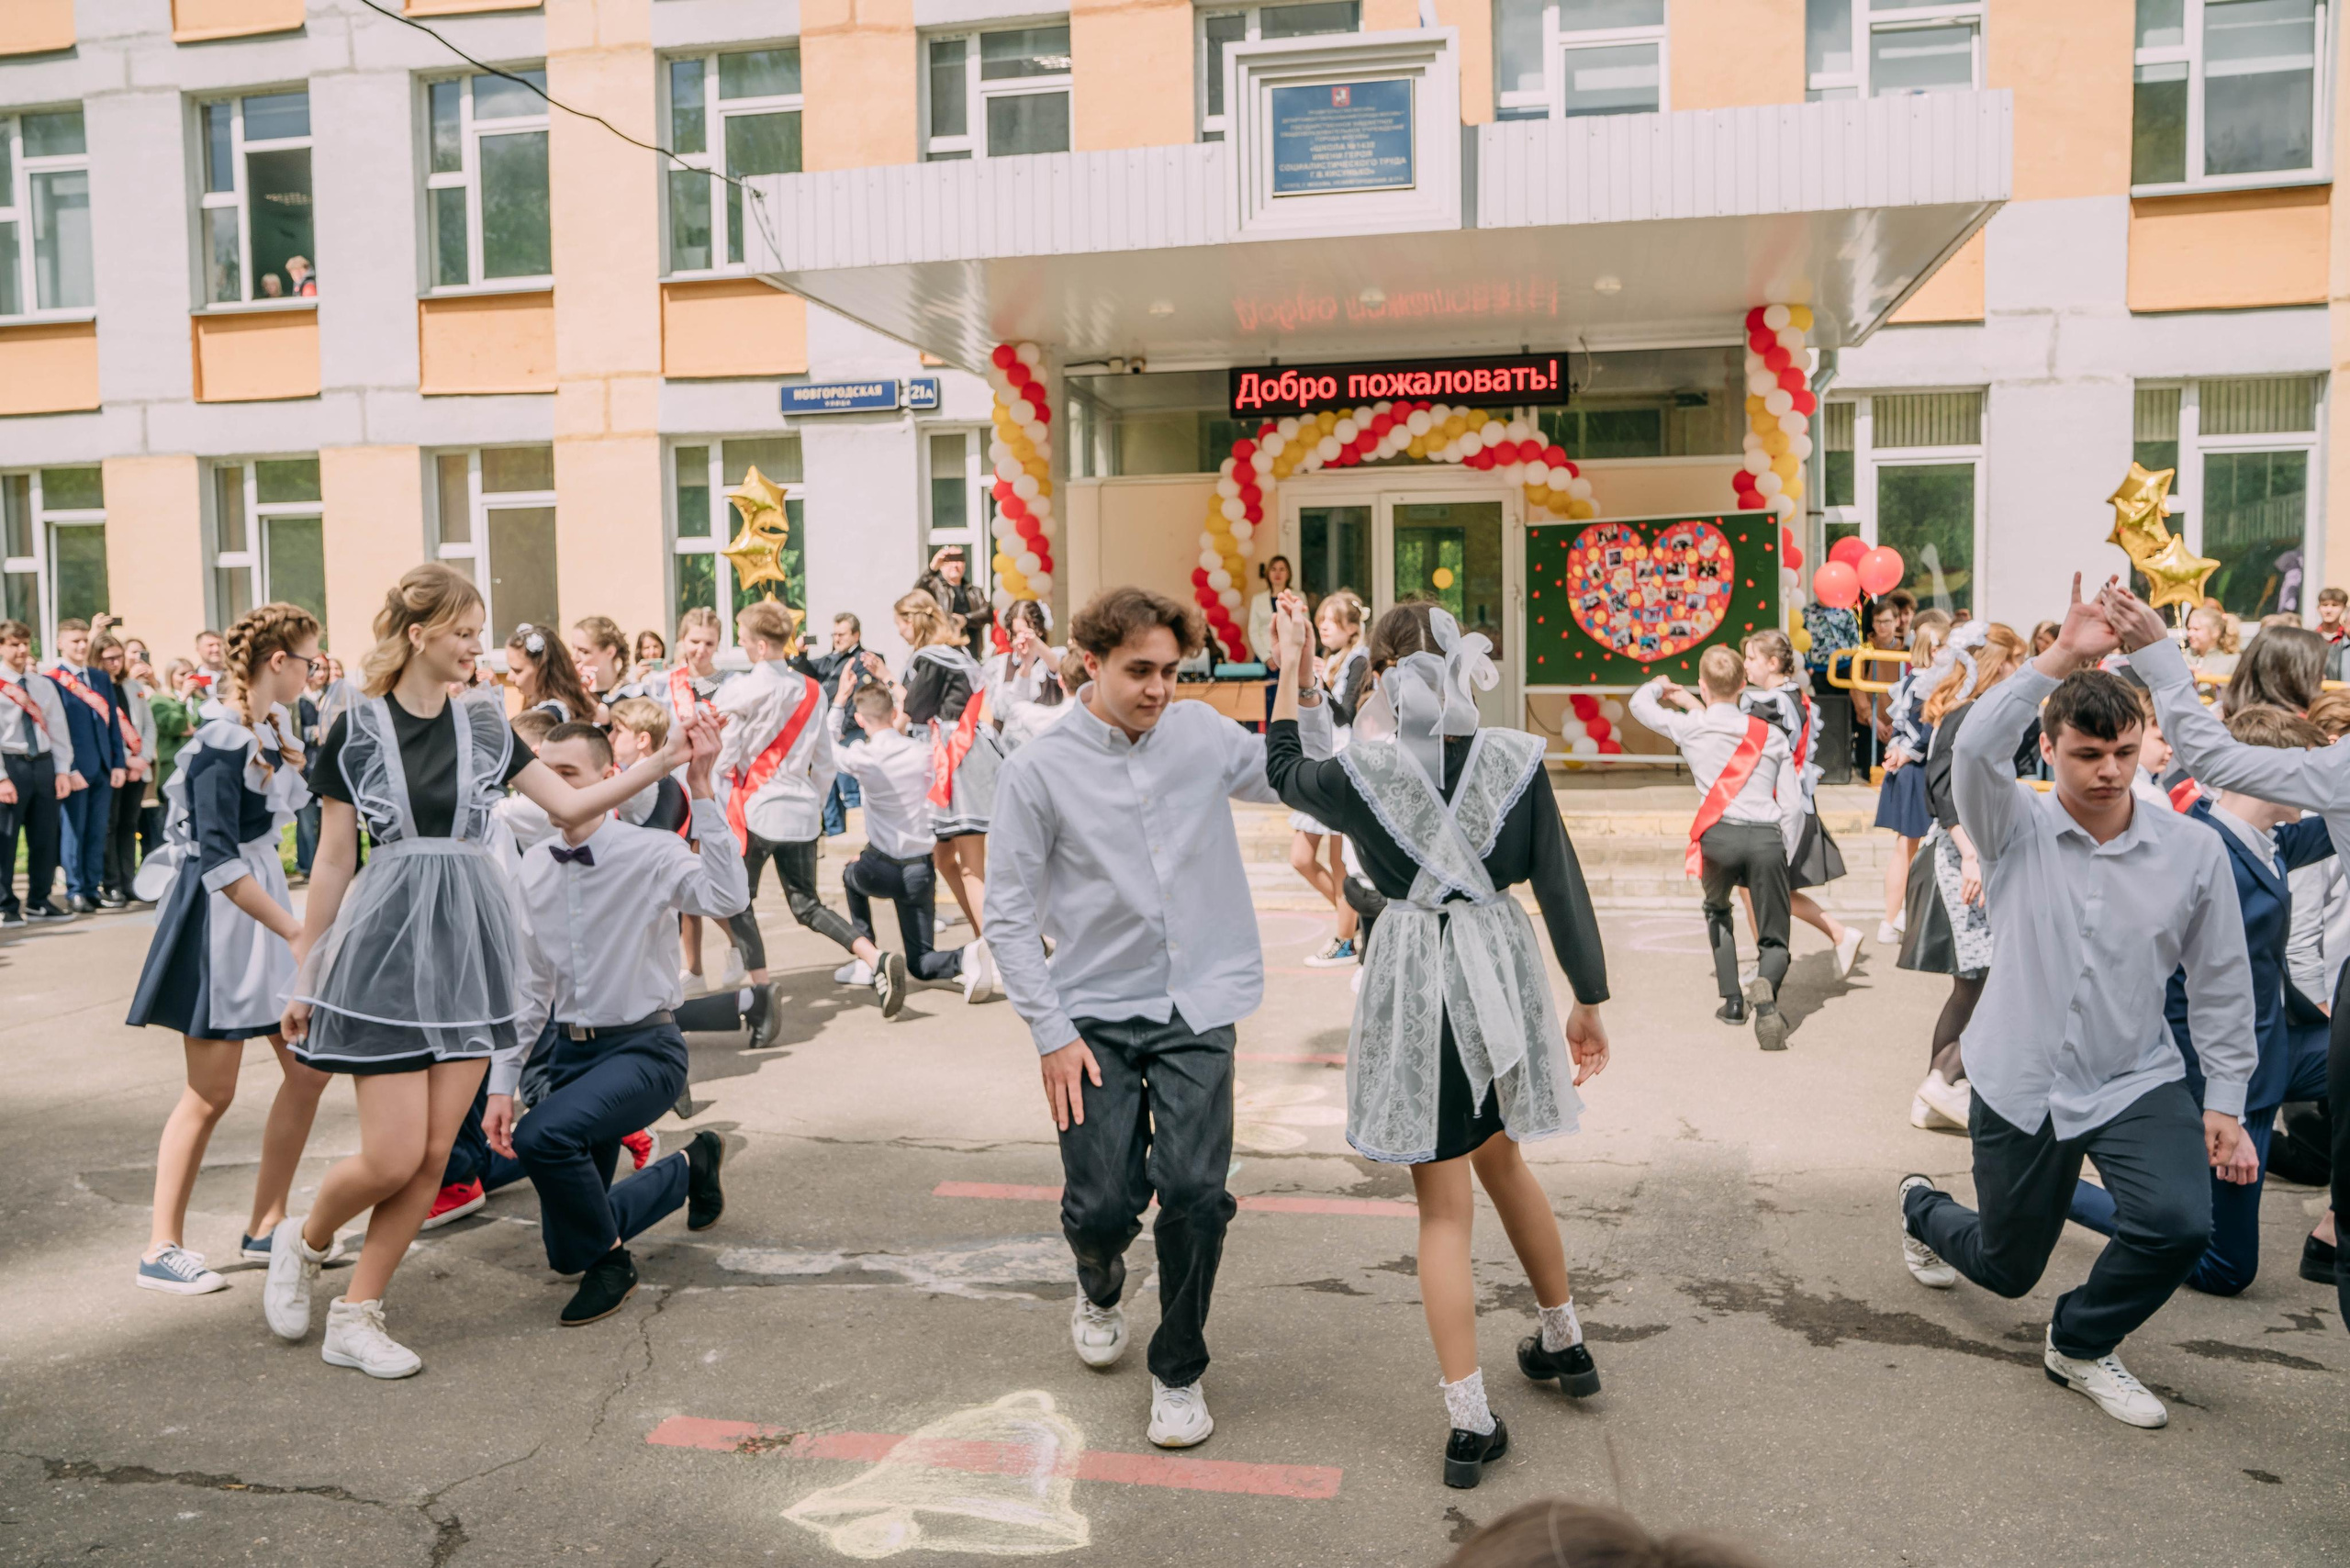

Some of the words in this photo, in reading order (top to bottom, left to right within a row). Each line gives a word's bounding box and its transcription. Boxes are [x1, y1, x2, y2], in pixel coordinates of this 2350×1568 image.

[1279, 159, 1377, 171] СОЦИАЛИСТИЧЕСКОГО
[1380, 157, 1406, 165] ТРУДА
[793, 384, 883, 401] НОВГОРОДСКАЯ
[1236, 370, 1337, 409] Добро
[1348, 359, 1559, 398] пожаловать!
